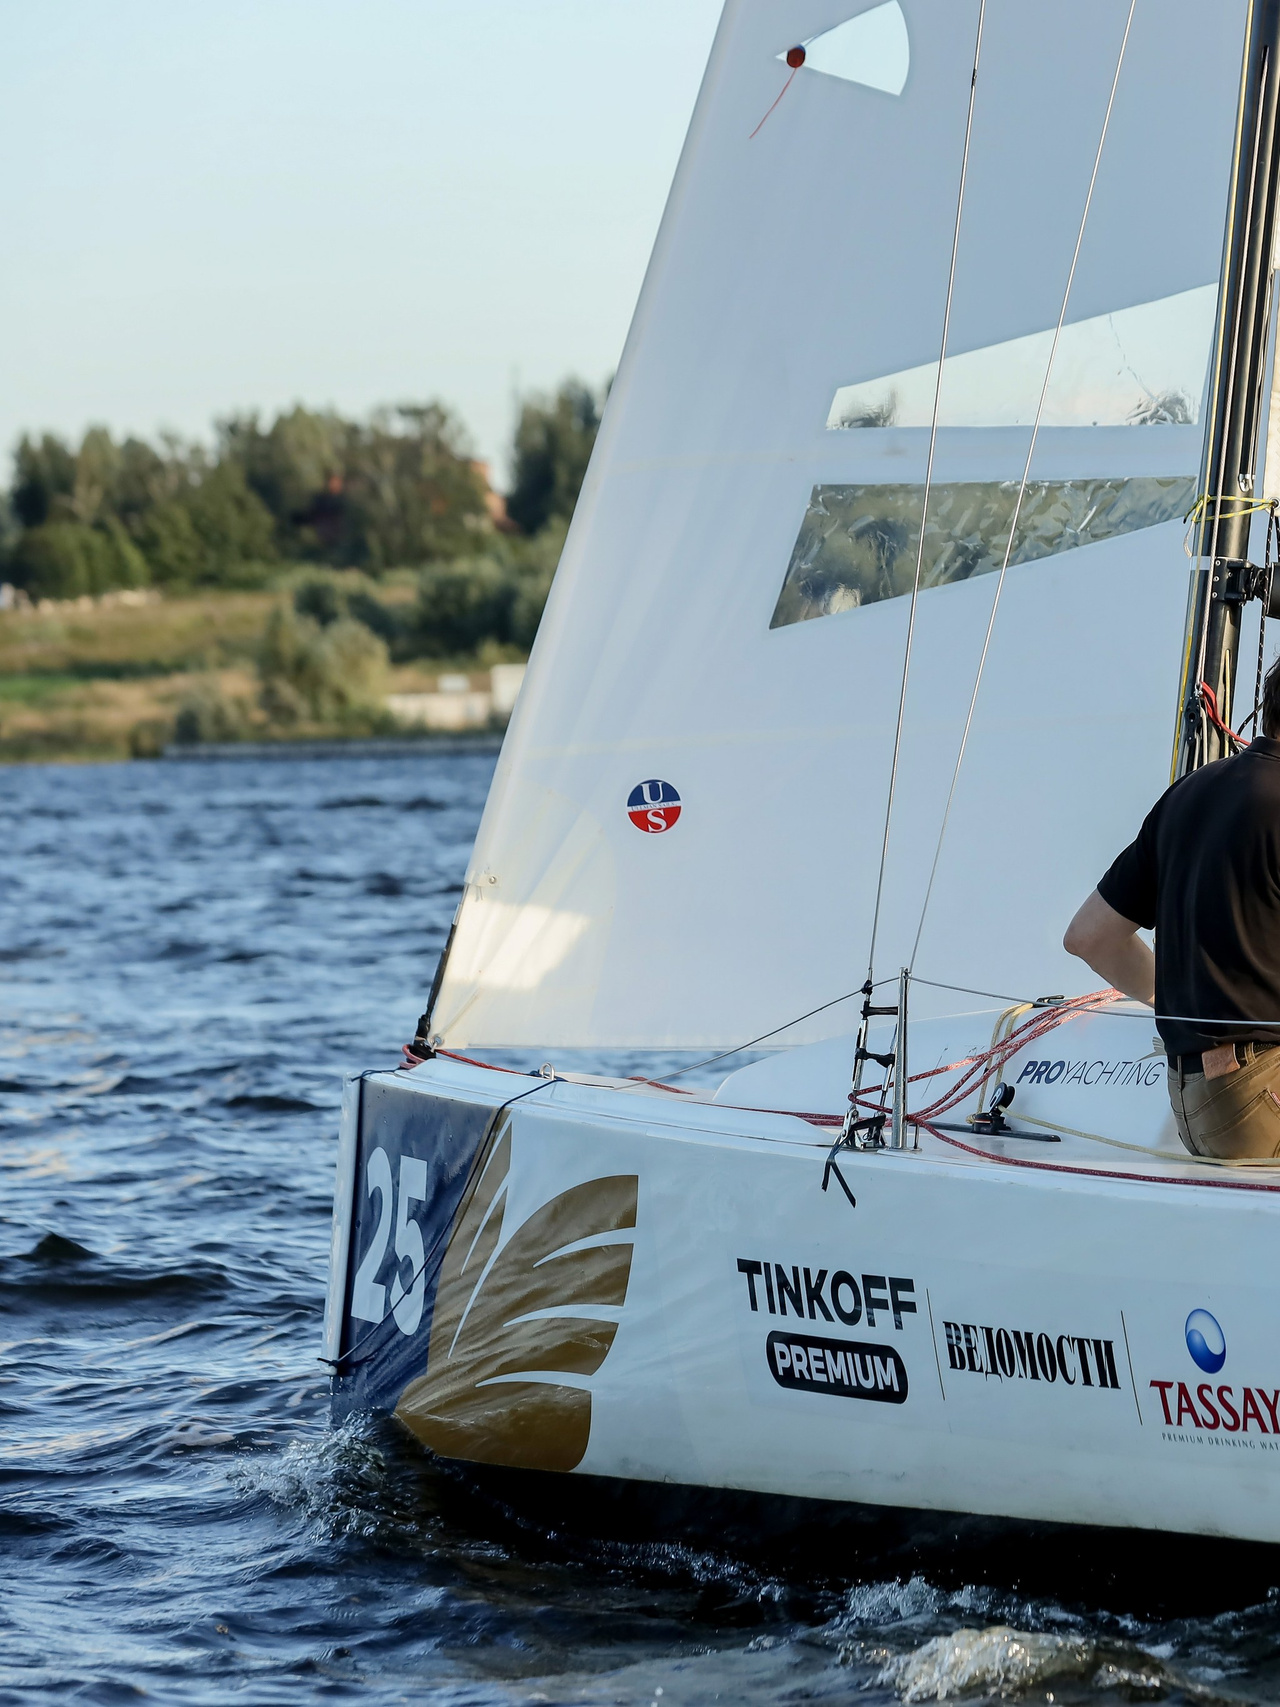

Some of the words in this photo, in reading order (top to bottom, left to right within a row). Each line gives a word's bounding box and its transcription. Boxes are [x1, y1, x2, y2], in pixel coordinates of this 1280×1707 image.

[641, 781, 664, 804] U
[646, 809, 667, 833] S
[1016, 1060, 1165, 1086] PROYACHTING
[351, 1146, 427, 1336] 25
[737, 1258, 917, 1330] TINKOFF
[773, 1342, 900, 1392] PREMIUM
[943, 1321, 1121, 1390] ВЕДОМОСТИ
[1162, 1432, 1204, 1445] PREMIUM
[1208, 1436, 1255, 1449] DRINKING
